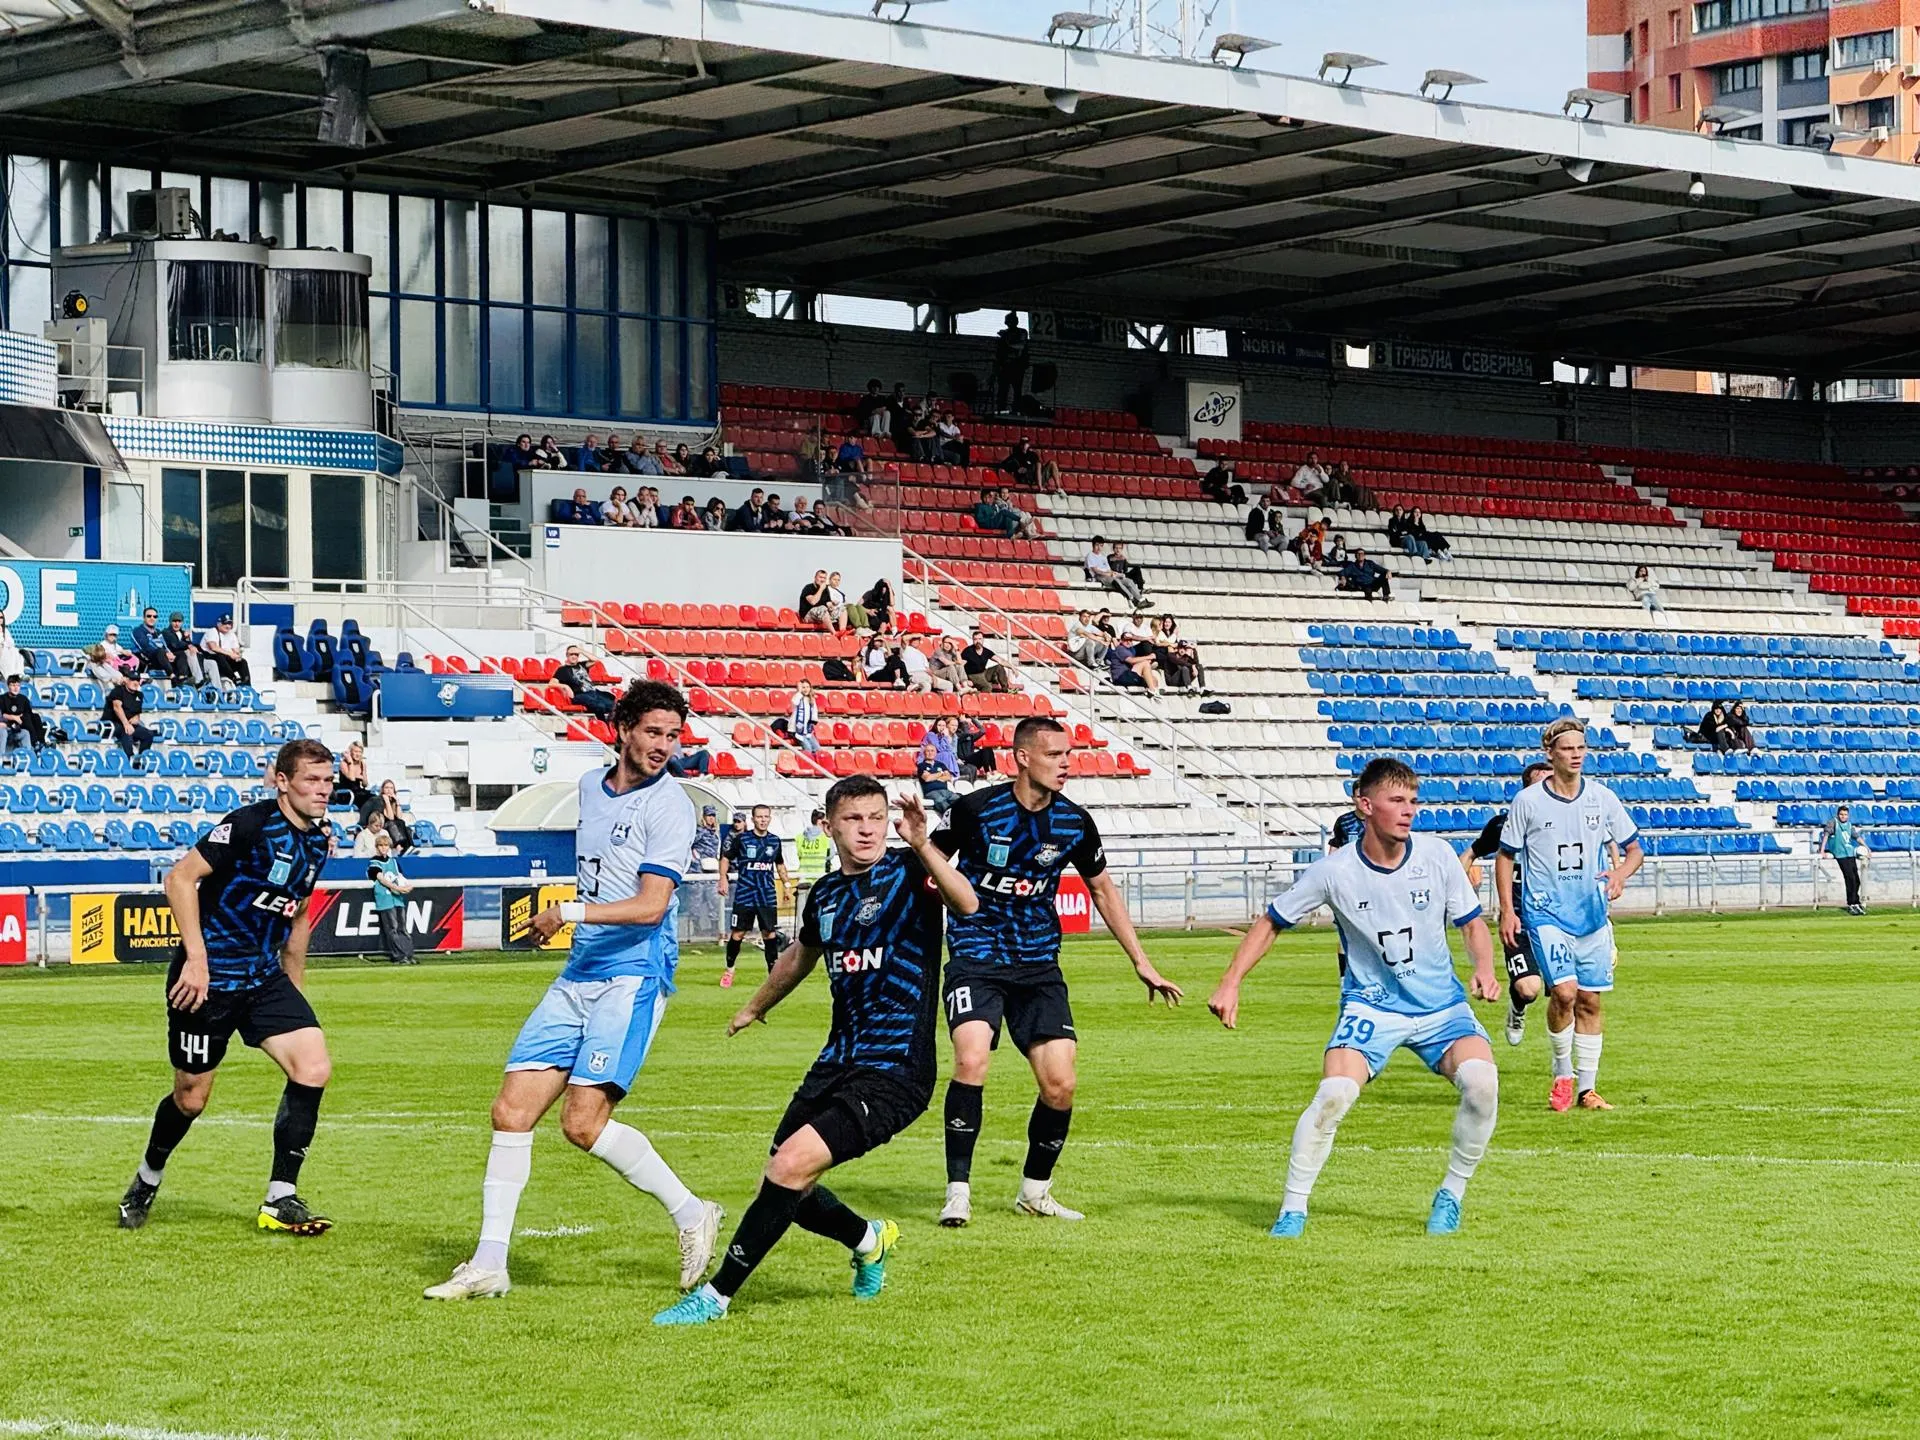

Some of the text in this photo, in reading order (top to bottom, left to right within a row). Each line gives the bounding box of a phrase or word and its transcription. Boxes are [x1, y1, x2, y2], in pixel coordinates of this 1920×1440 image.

[1242, 338, 1287, 356] NORTH
[1395, 346, 1534, 377] ТРИБУНА СЕВЕРНАЯ
[746, 861, 773, 871] LEON
[980, 872, 1049, 897] LEON
[82, 910, 104, 929] HATE
[335, 900, 433, 937] LEN
[82, 928, 104, 947] HATS
[1507, 953, 1529, 977] 43
[1550, 943, 1571, 964] 42
[1336, 1015, 1376, 1045] 39
[180, 1031, 210, 1064] 44
